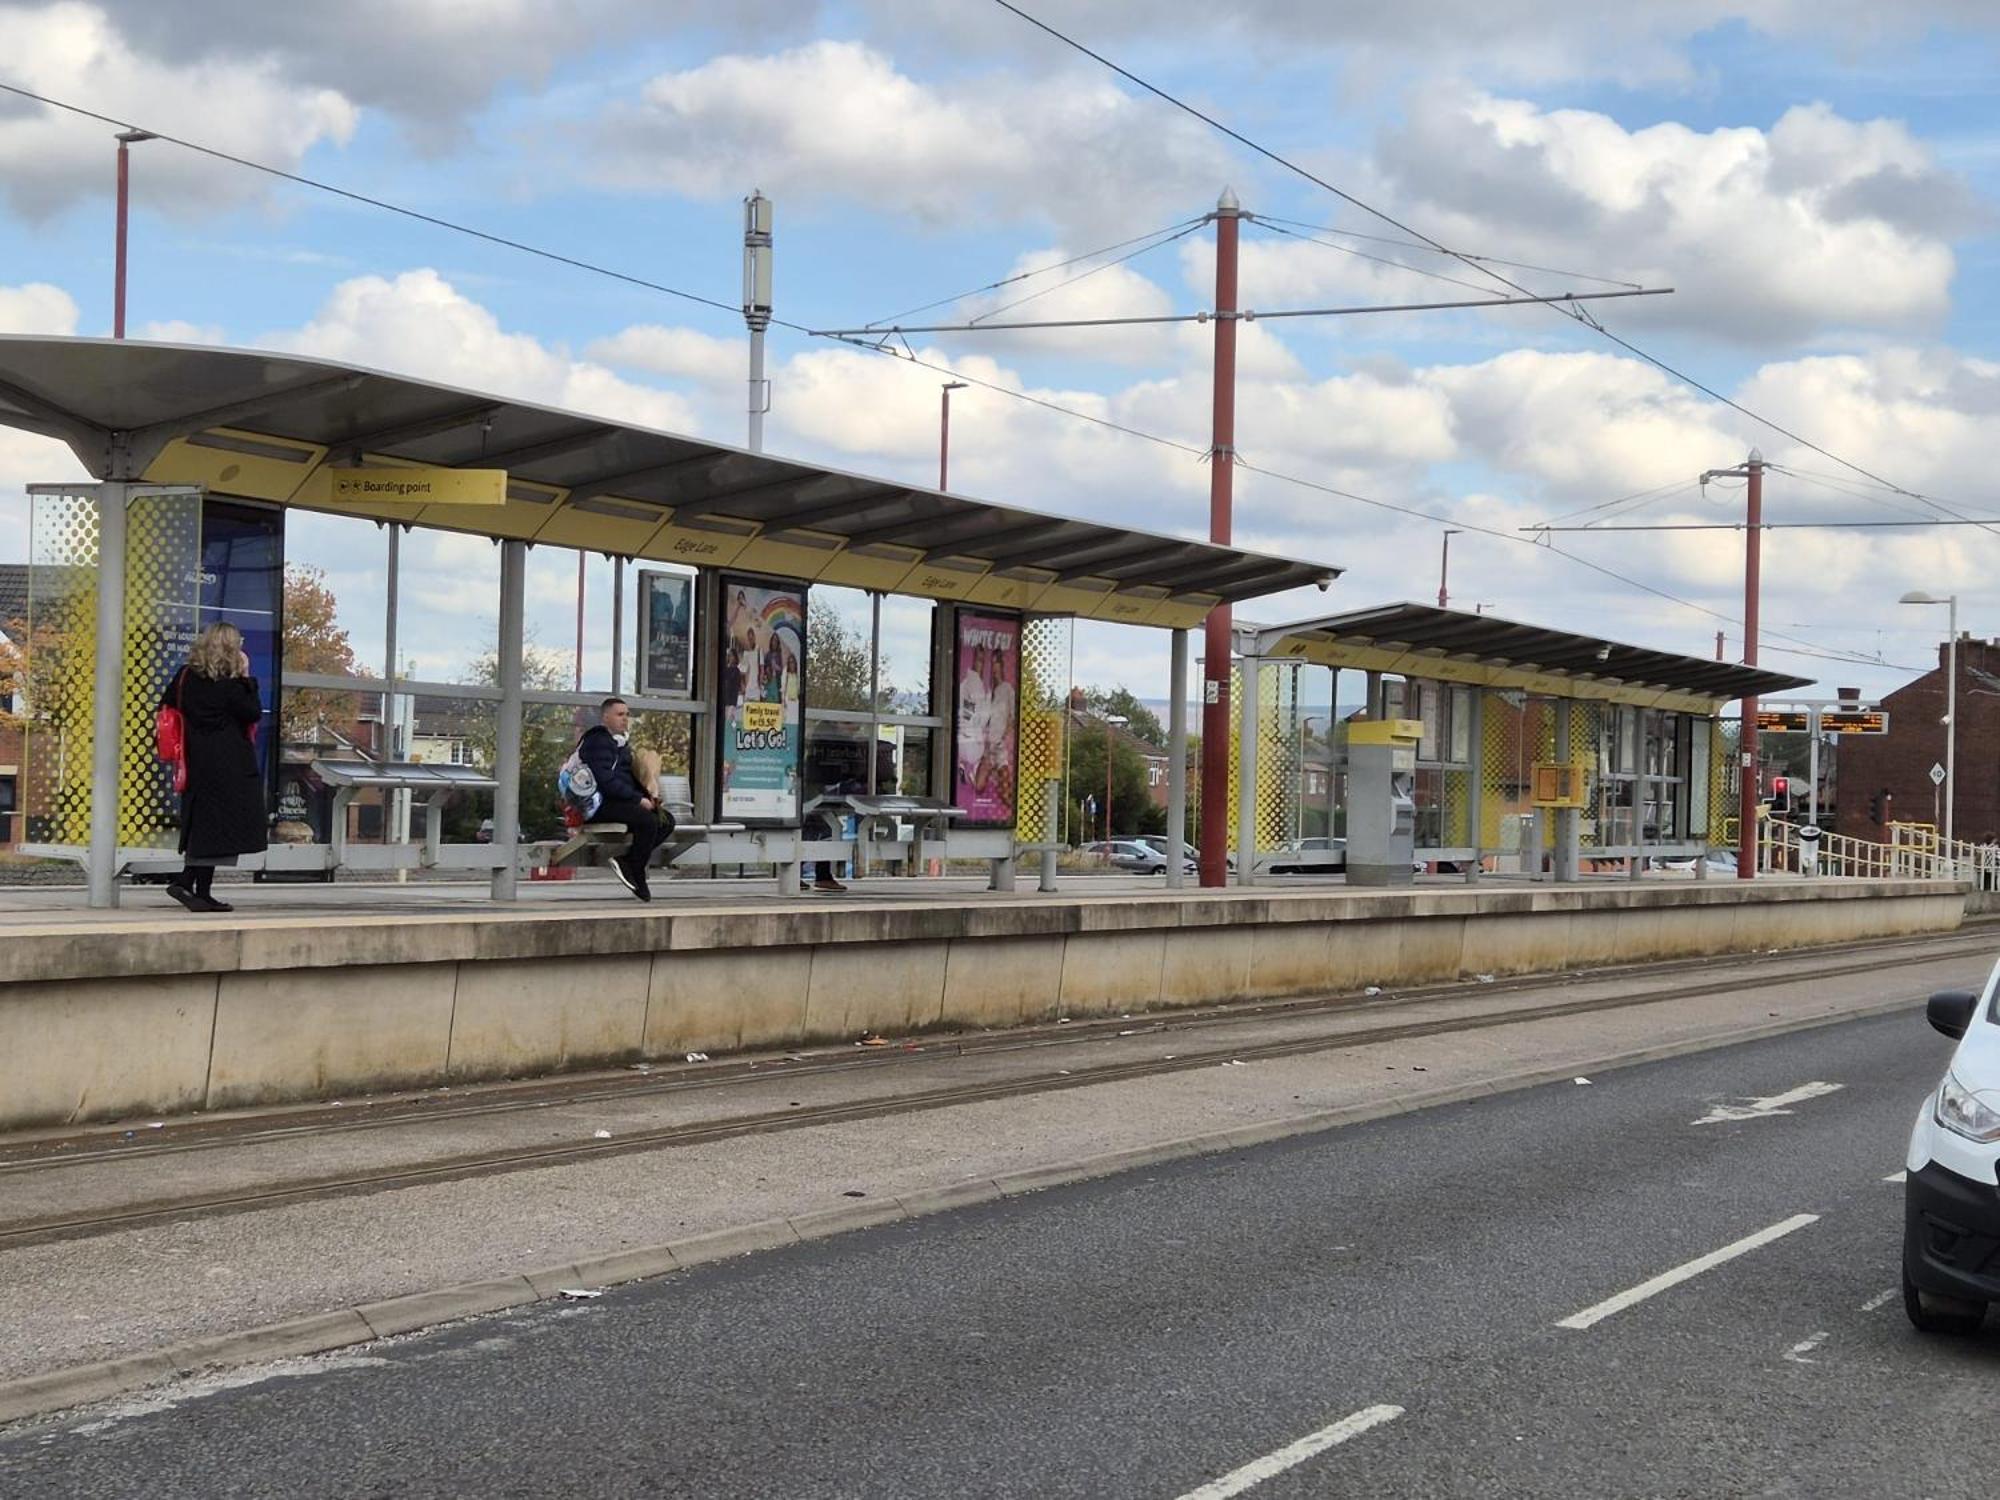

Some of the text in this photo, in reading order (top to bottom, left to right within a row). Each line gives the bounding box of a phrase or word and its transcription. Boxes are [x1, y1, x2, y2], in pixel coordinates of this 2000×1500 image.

[363, 480, 431, 495] Boarding point
[674, 538, 719, 554] Edge Lane
[736, 728, 787, 750] Let's Go!
